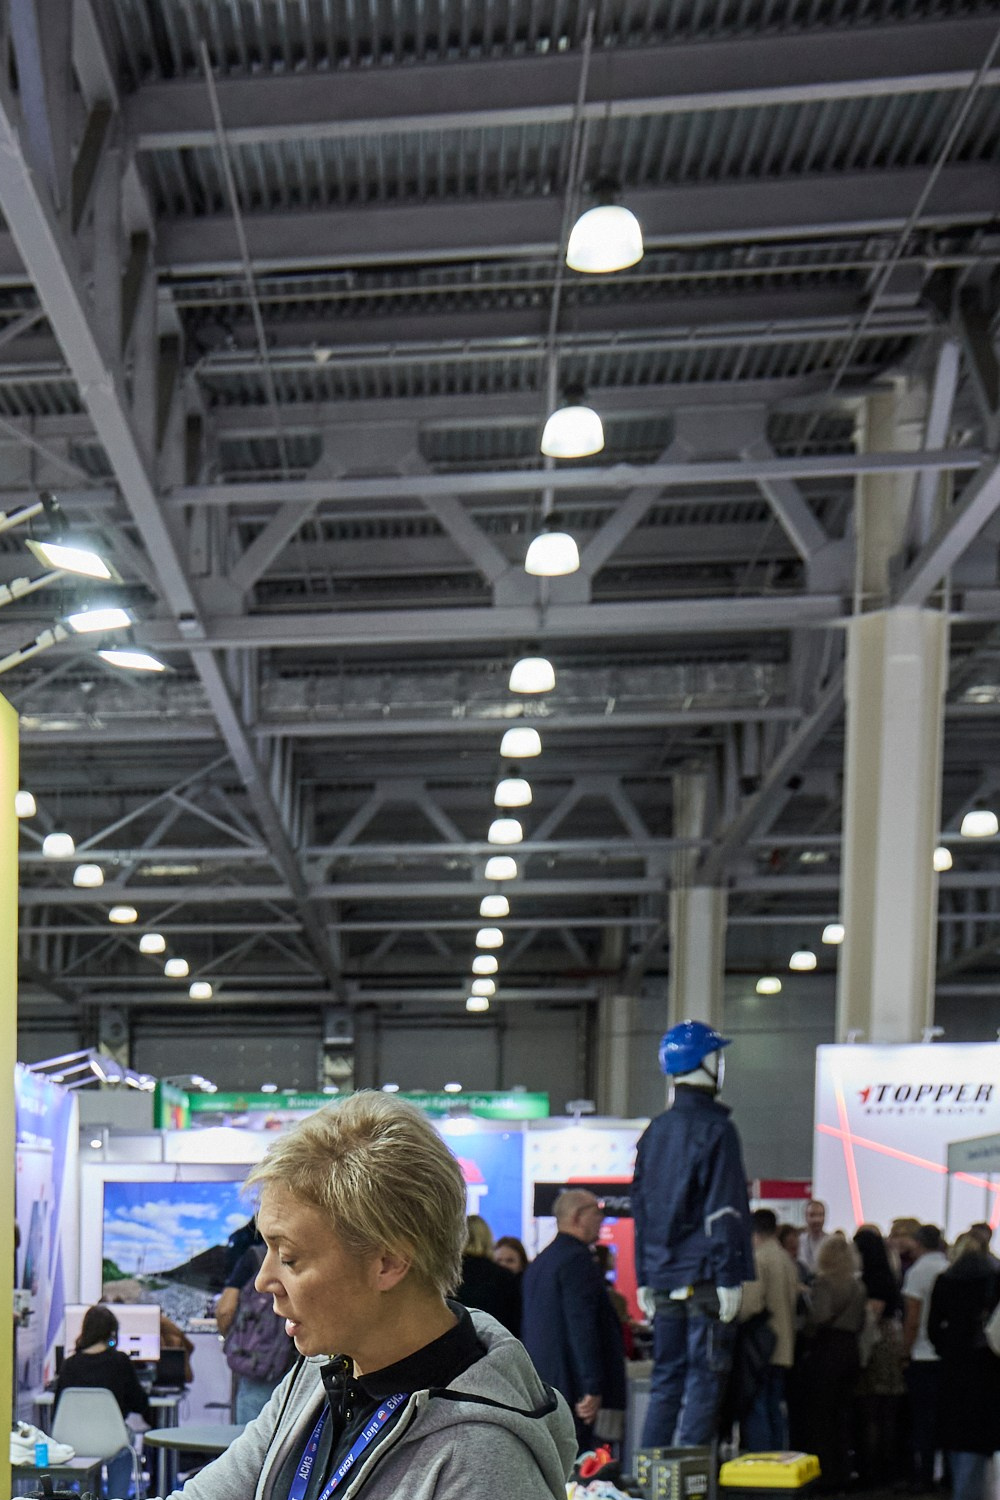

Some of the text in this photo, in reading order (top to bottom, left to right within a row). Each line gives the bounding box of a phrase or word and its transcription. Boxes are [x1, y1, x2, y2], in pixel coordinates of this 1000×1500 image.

[877, 1083, 994, 1103] TOPPER
[386, 1392, 406, 1410] СИЗ
[298, 1456, 313, 1480] АСИЗ
[338, 1454, 354, 1477] АСИЗ
